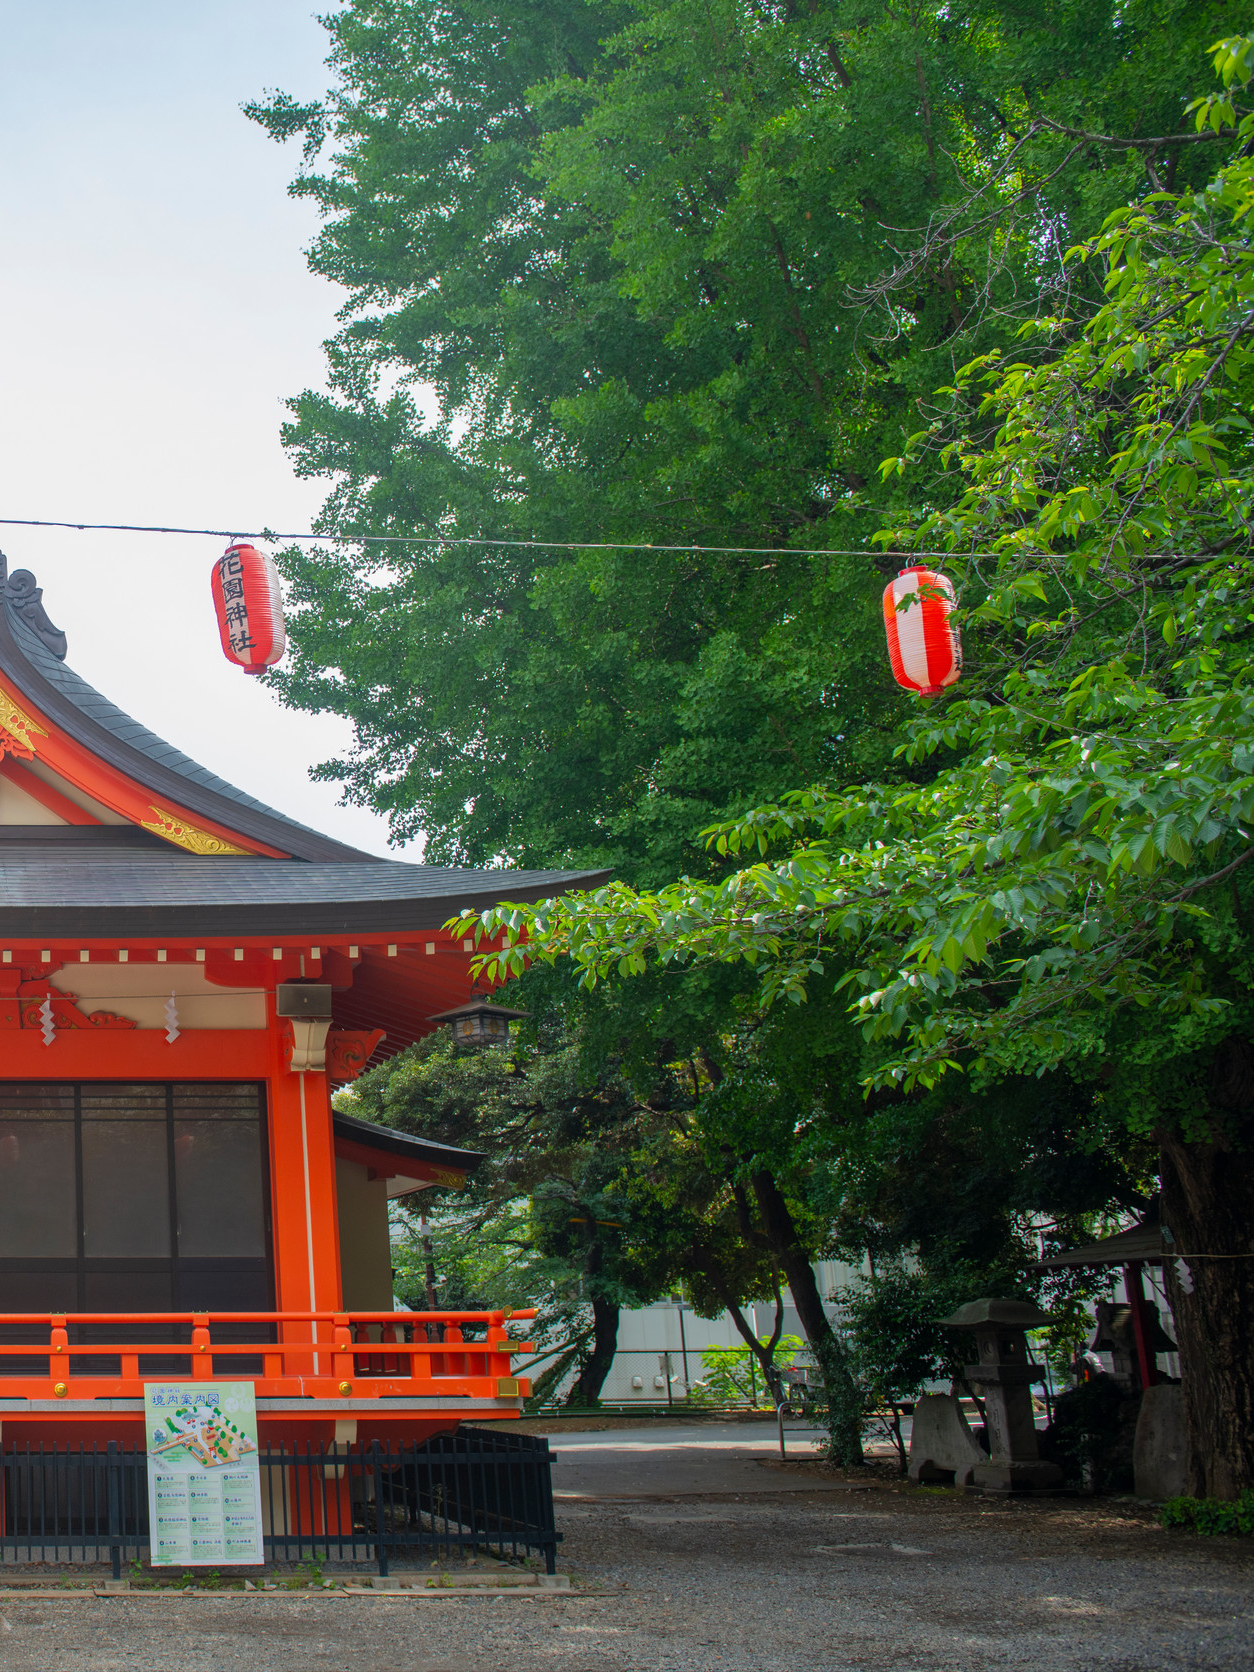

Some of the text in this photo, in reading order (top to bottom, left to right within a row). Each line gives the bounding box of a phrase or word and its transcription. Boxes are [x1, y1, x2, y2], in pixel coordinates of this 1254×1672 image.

[218, 552, 257, 654] 花園神社
[152, 1394, 220, 1406] 境内案内図
